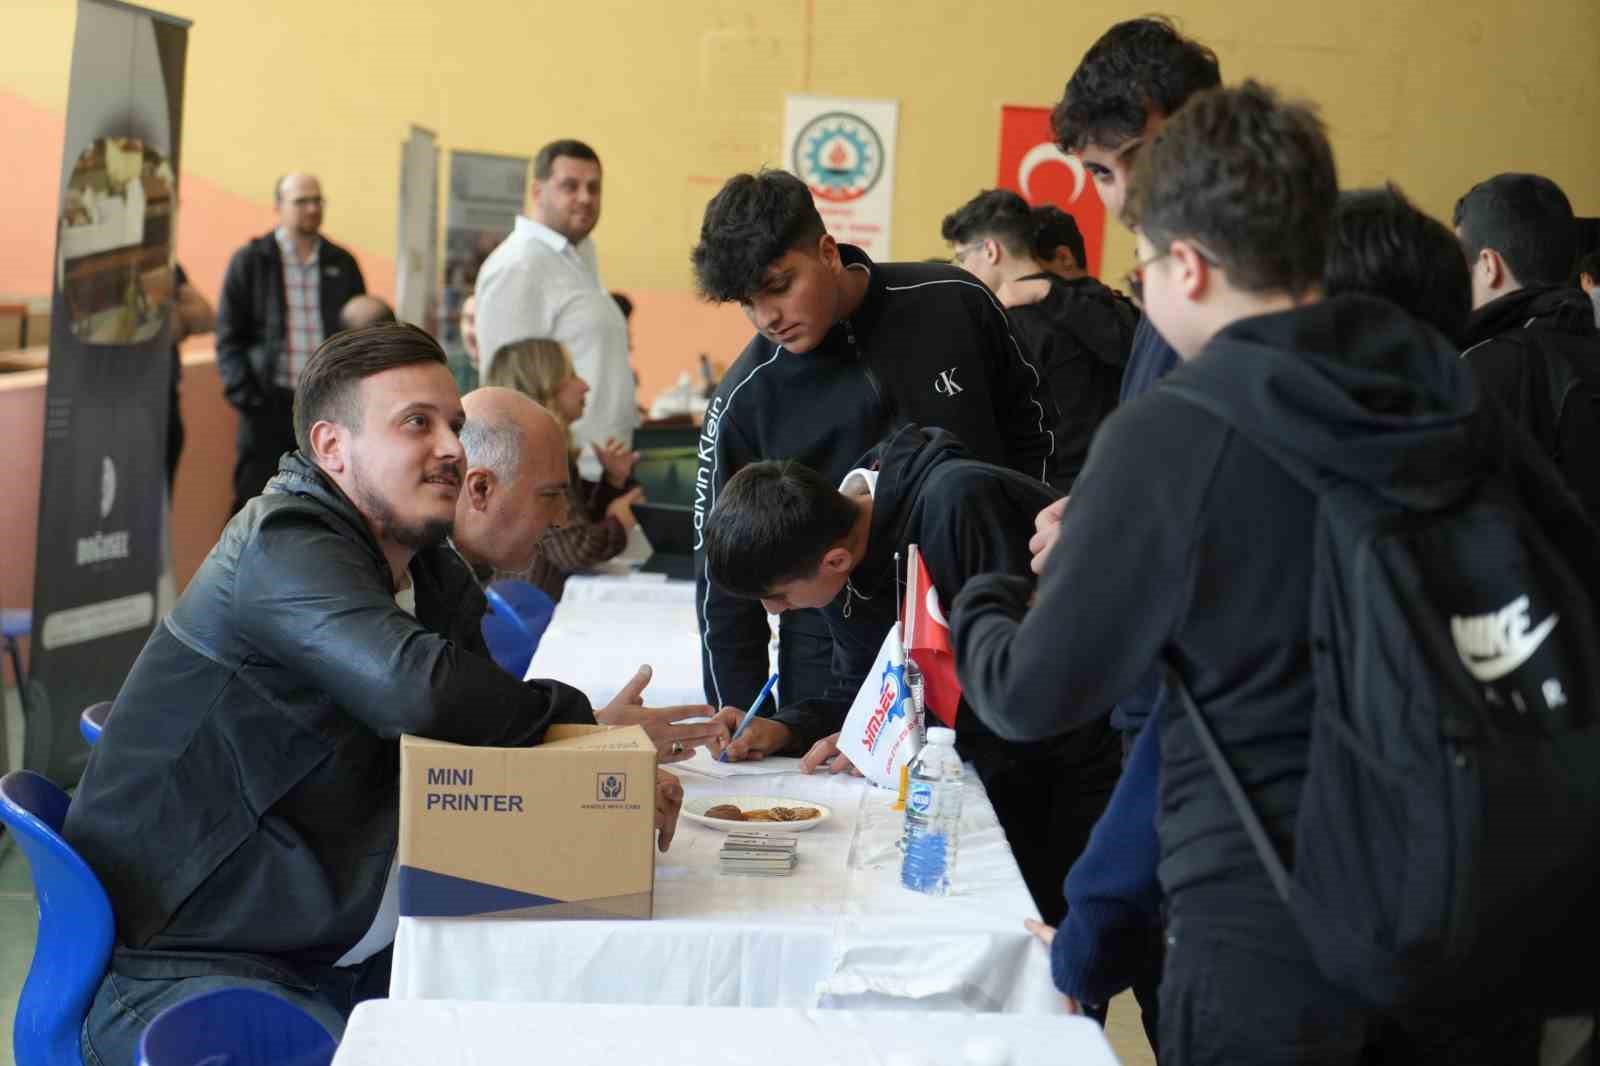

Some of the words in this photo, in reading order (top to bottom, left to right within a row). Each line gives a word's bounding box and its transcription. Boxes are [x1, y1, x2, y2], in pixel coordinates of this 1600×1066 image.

[698, 397, 721, 462] Klein
[427, 768, 474, 786] MINI
[426, 793, 523, 812] PRINTER
